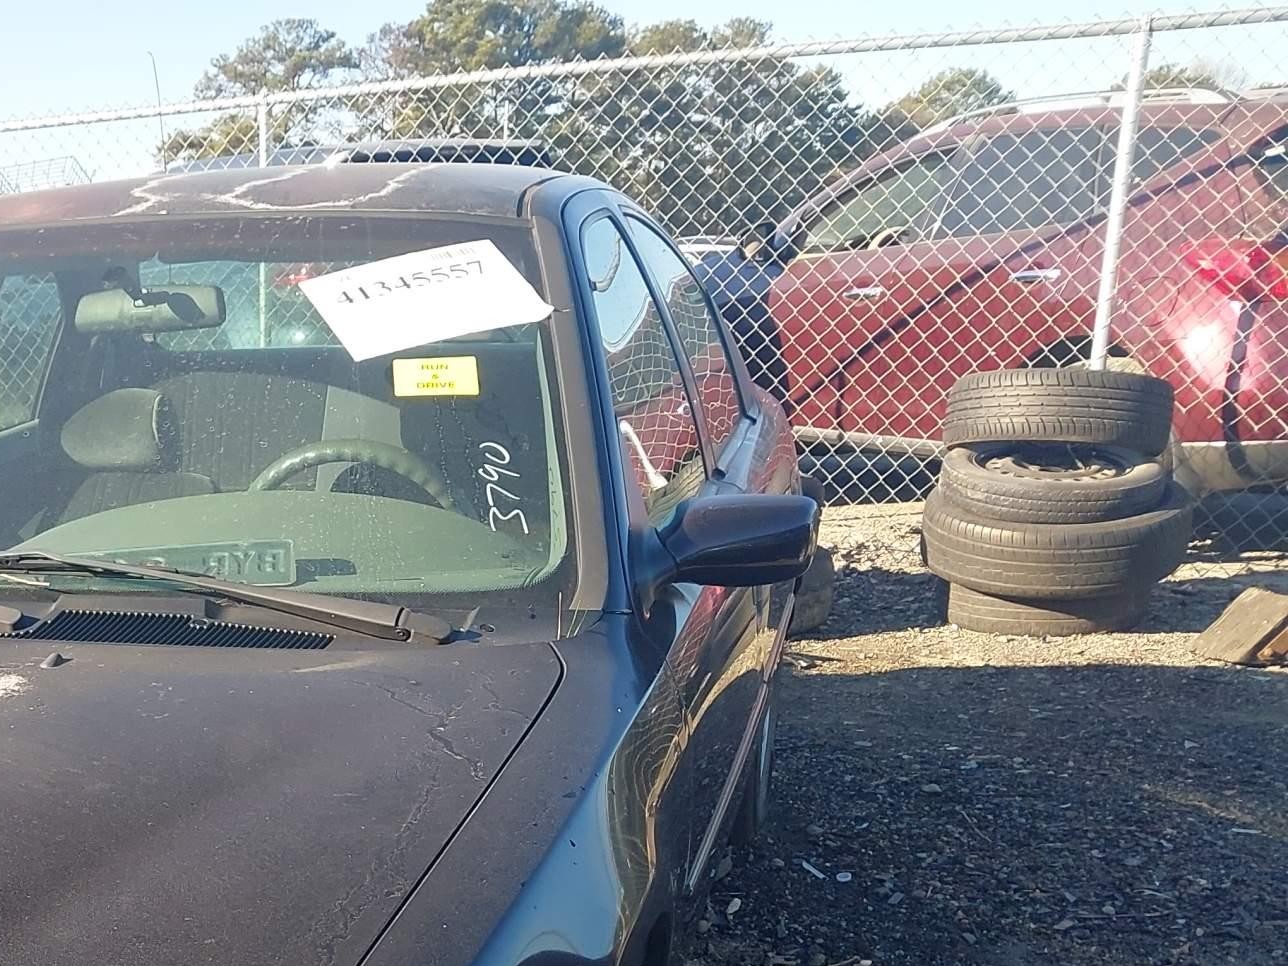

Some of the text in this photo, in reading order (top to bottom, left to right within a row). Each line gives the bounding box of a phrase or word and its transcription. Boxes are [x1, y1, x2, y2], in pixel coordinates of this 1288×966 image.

[337, 260, 484, 304] 41345557
[420, 363, 449, 371] RUN
[416, 381, 456, 390] DRIVE
[478, 441, 529, 534] 3790
